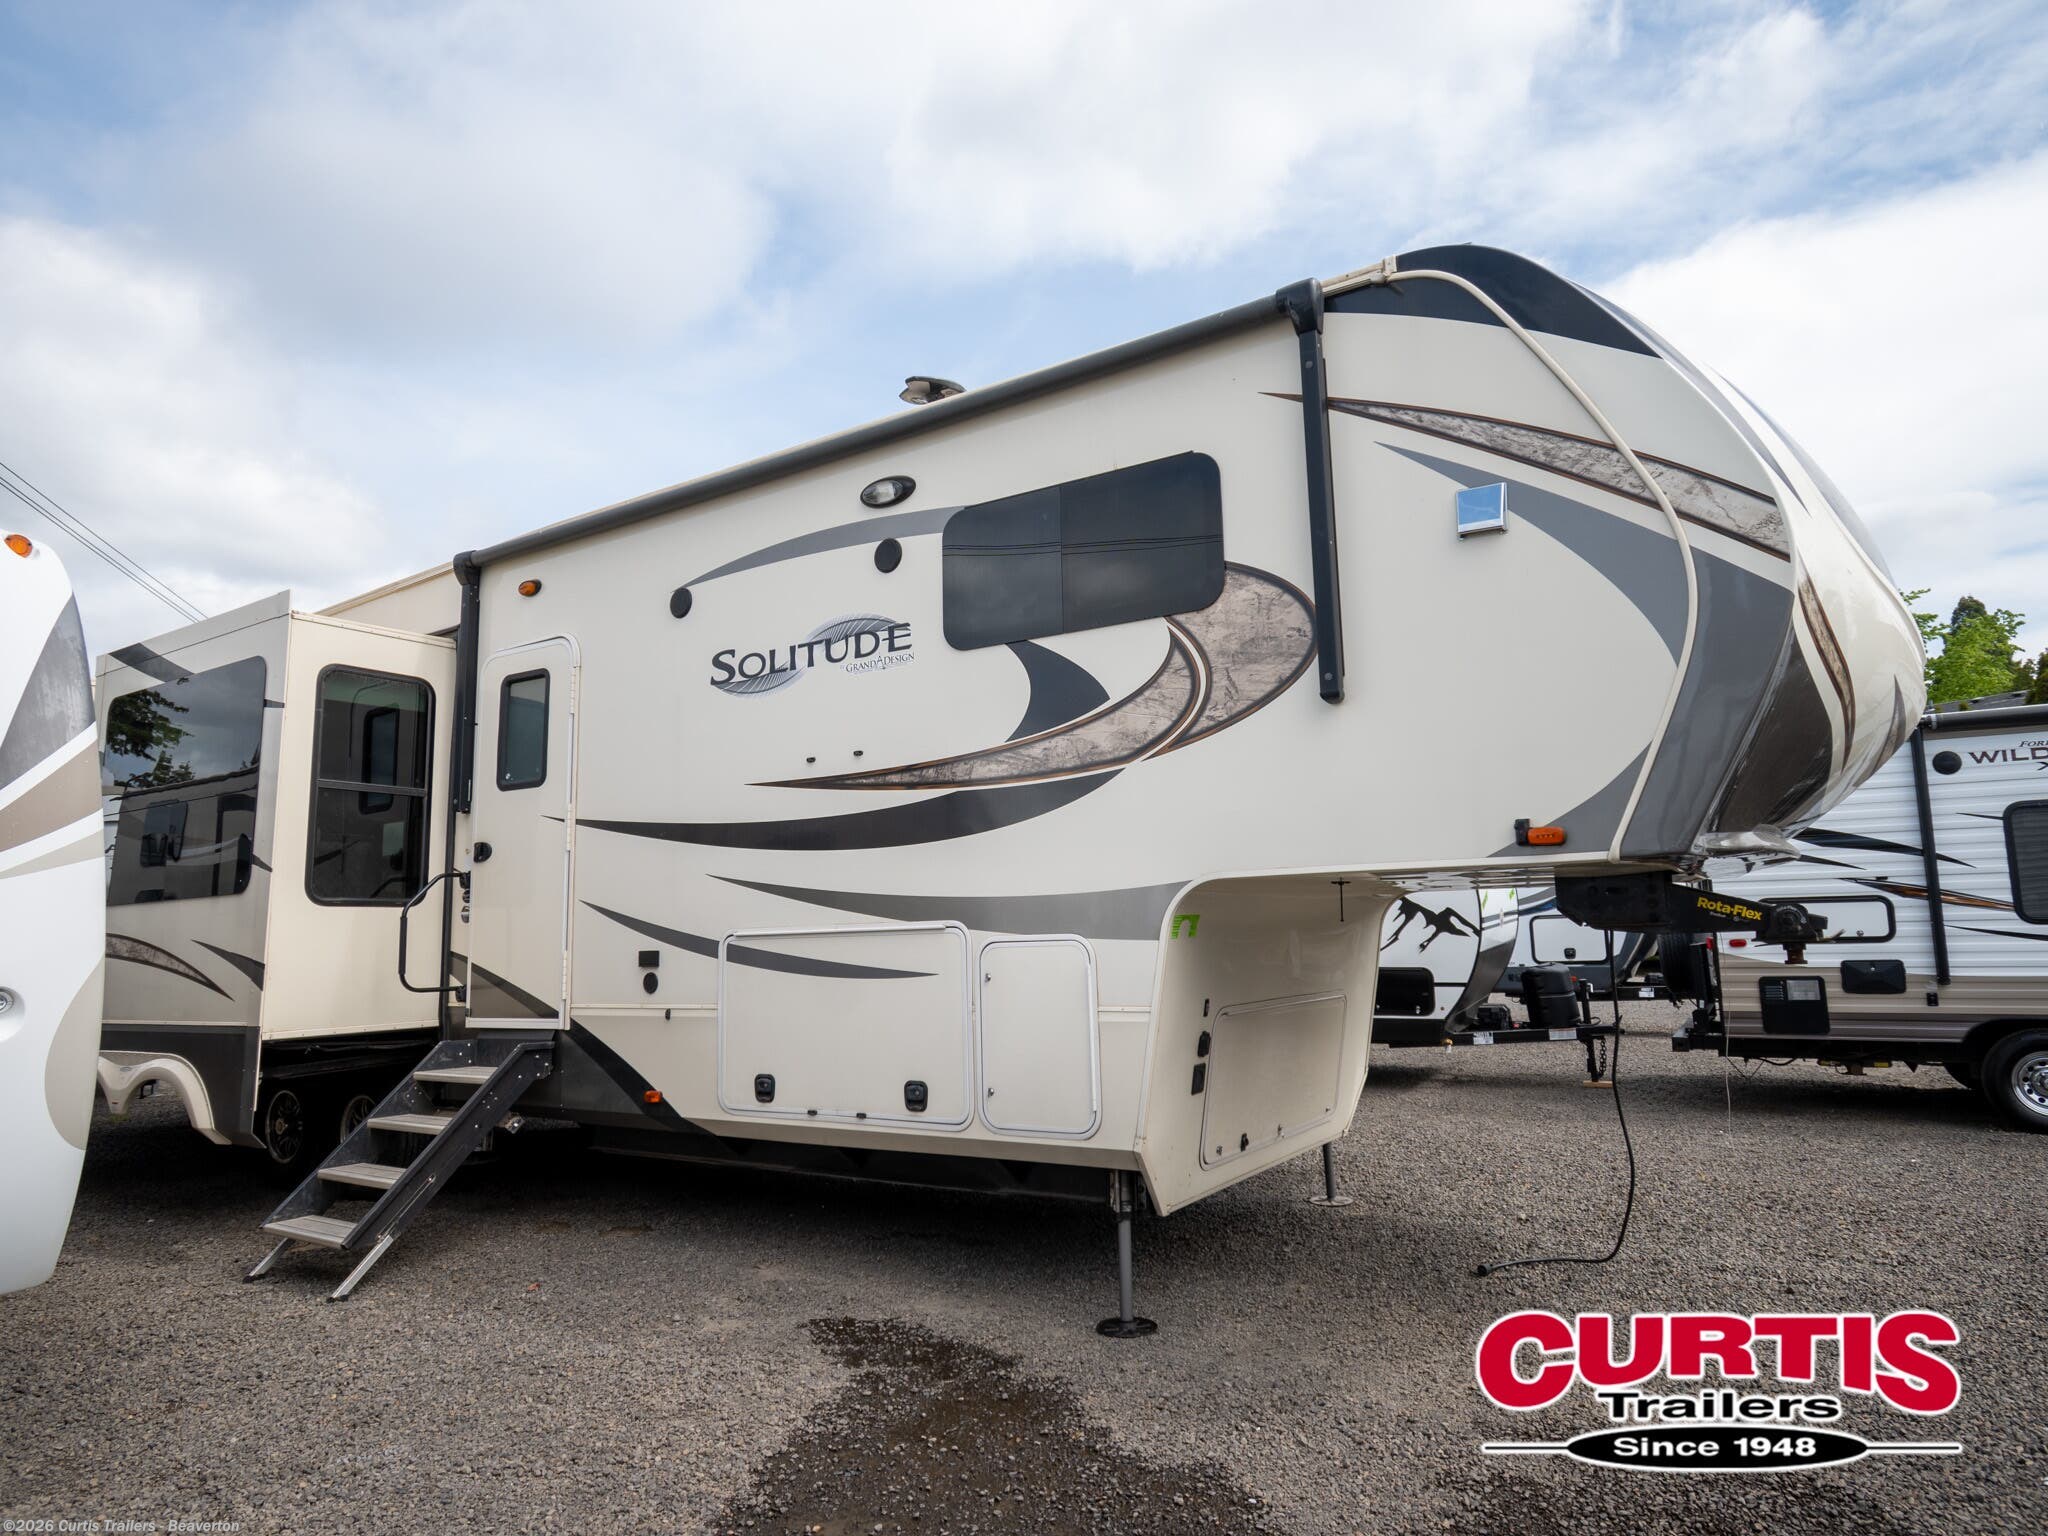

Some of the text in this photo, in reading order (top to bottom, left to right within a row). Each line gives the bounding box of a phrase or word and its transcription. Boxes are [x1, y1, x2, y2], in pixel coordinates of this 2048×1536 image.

[710, 622, 913, 686] SOLITUDE
[845, 658, 877, 673] GRAND
[883, 652, 915, 666] DESIGN
